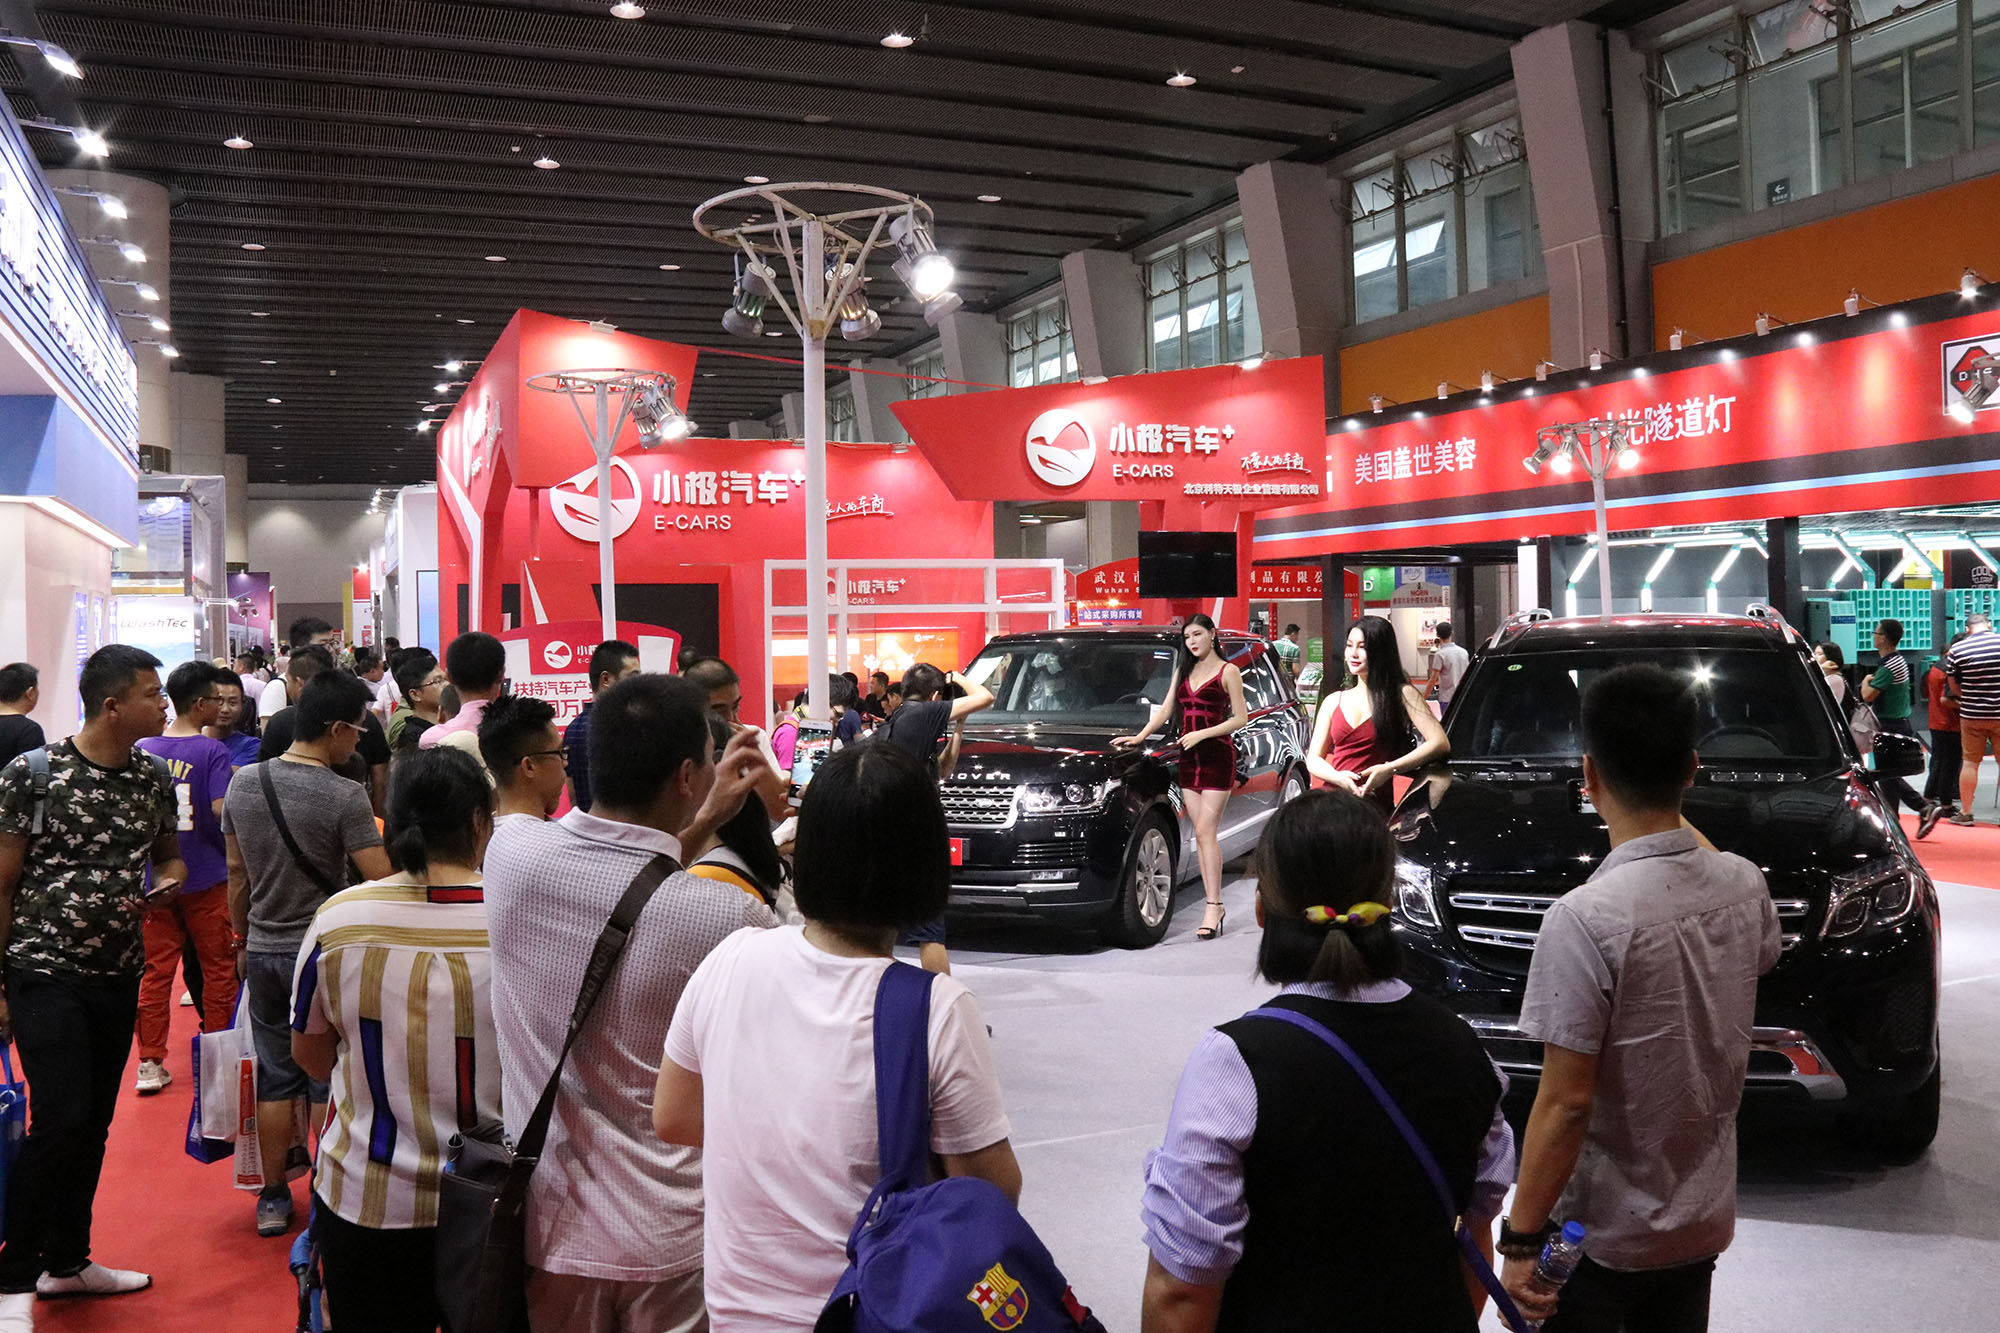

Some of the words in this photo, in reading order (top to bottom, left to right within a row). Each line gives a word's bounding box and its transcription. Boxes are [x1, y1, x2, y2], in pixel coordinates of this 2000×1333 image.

[1355, 437, 1477, 486] 美国盖世美容
[1112, 463, 1175, 478] E-CARS
[654, 514, 732, 530] E-CARS
